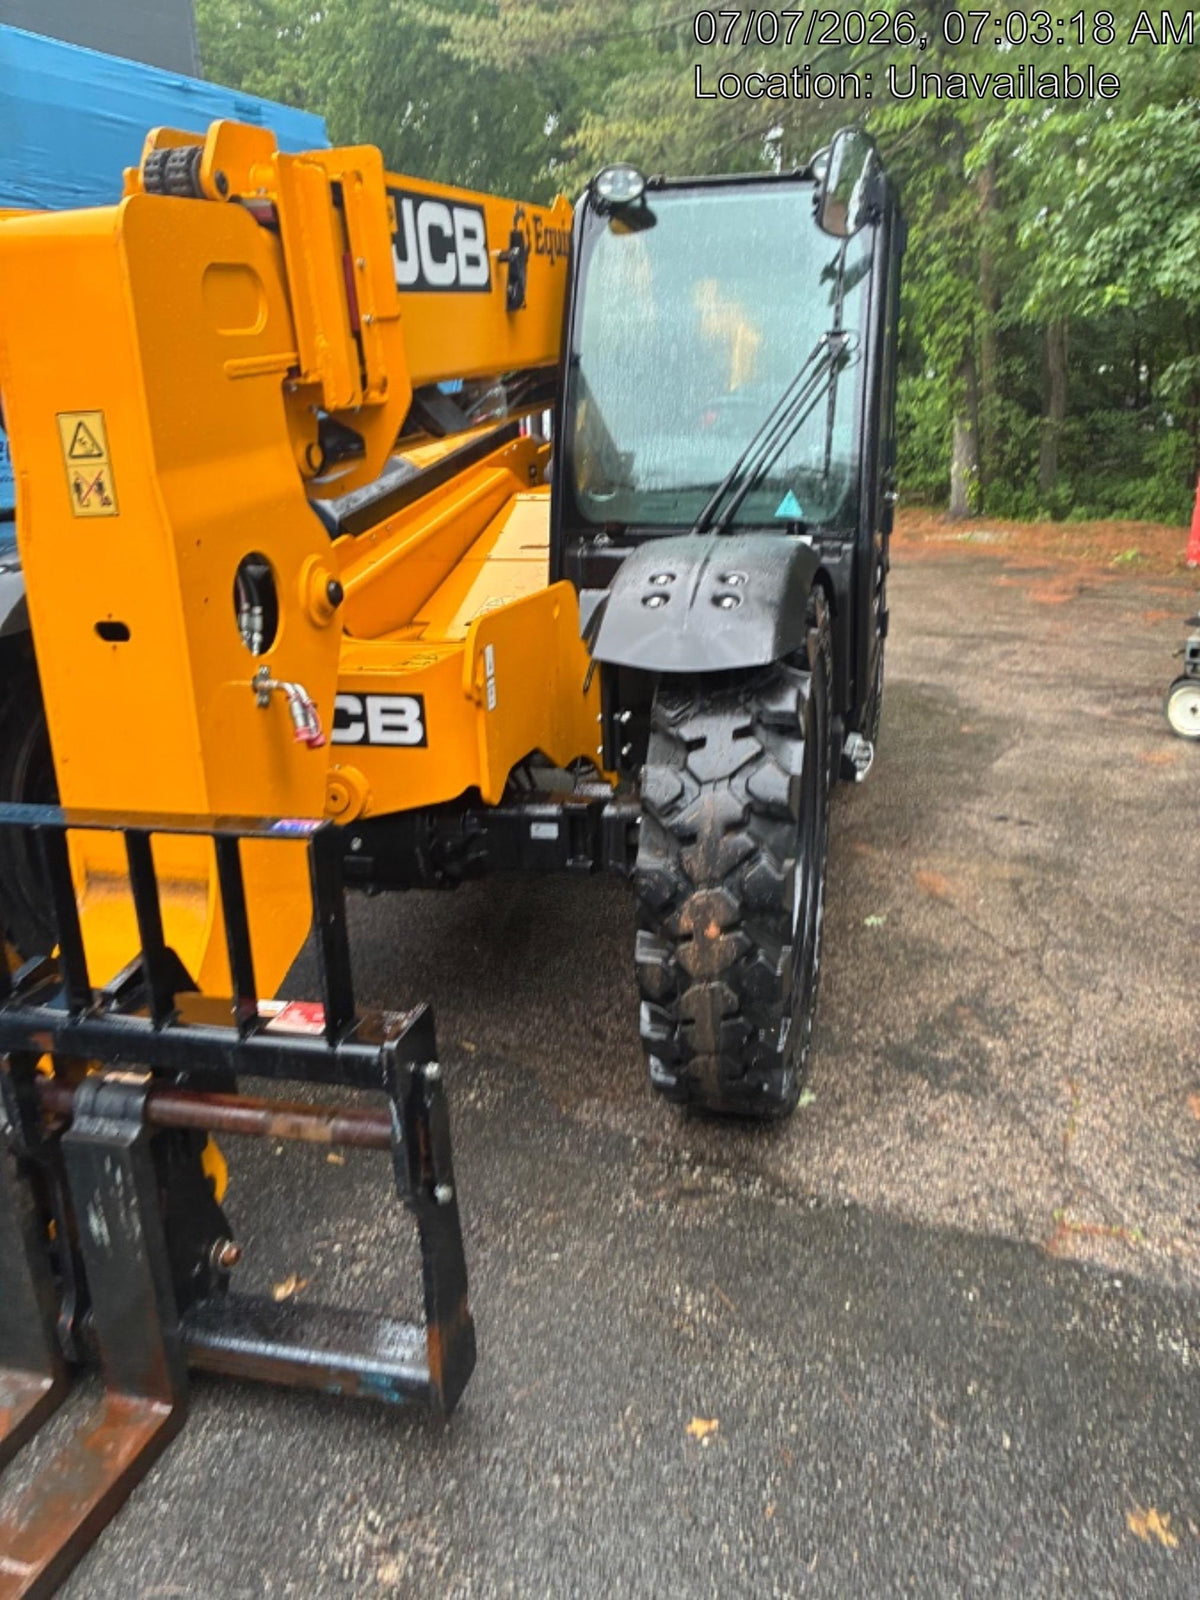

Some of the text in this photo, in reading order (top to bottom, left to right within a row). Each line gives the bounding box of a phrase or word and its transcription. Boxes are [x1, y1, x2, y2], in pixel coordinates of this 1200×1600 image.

[391, 197, 490, 286] JCB
[533, 214, 570, 266] Equi
[331, 694, 424, 745] CB
